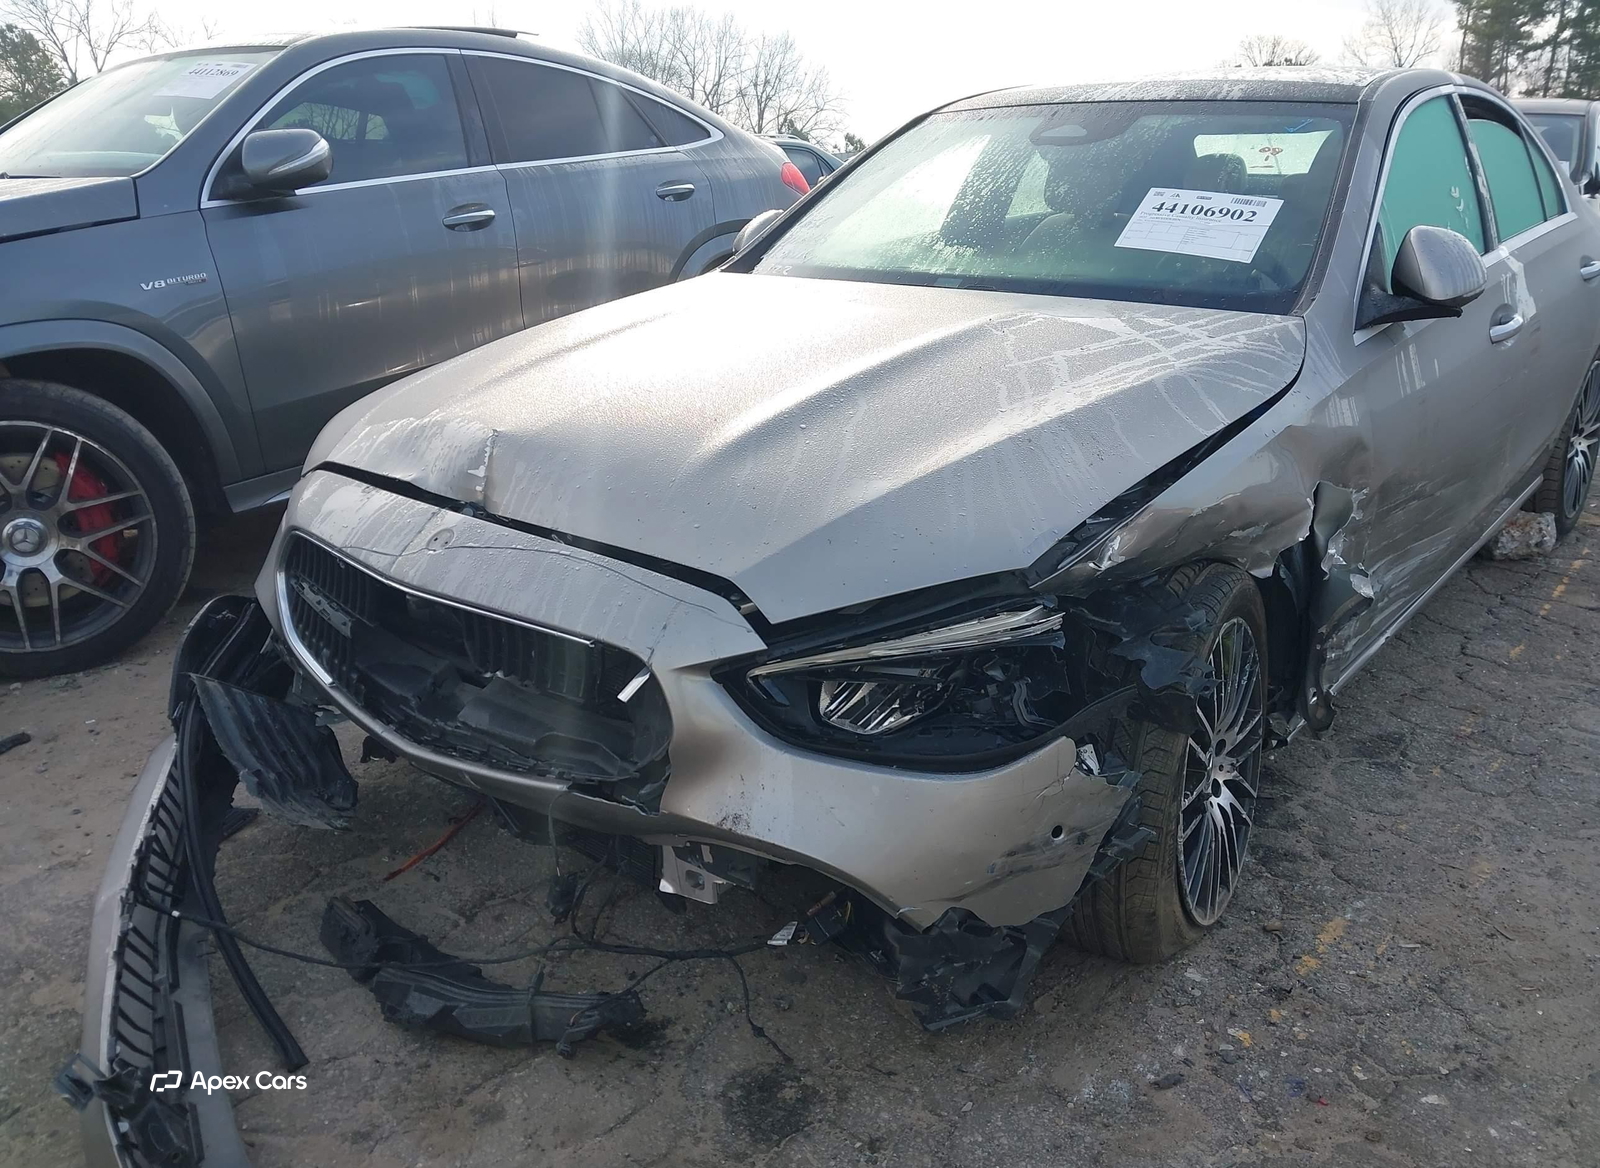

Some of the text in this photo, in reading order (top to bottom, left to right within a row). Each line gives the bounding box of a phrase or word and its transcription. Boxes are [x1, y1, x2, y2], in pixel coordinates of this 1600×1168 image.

[188, 68, 239, 77] 44112869
[1152, 201, 1258, 223] 44106902
[139, 279, 166, 291] V8
